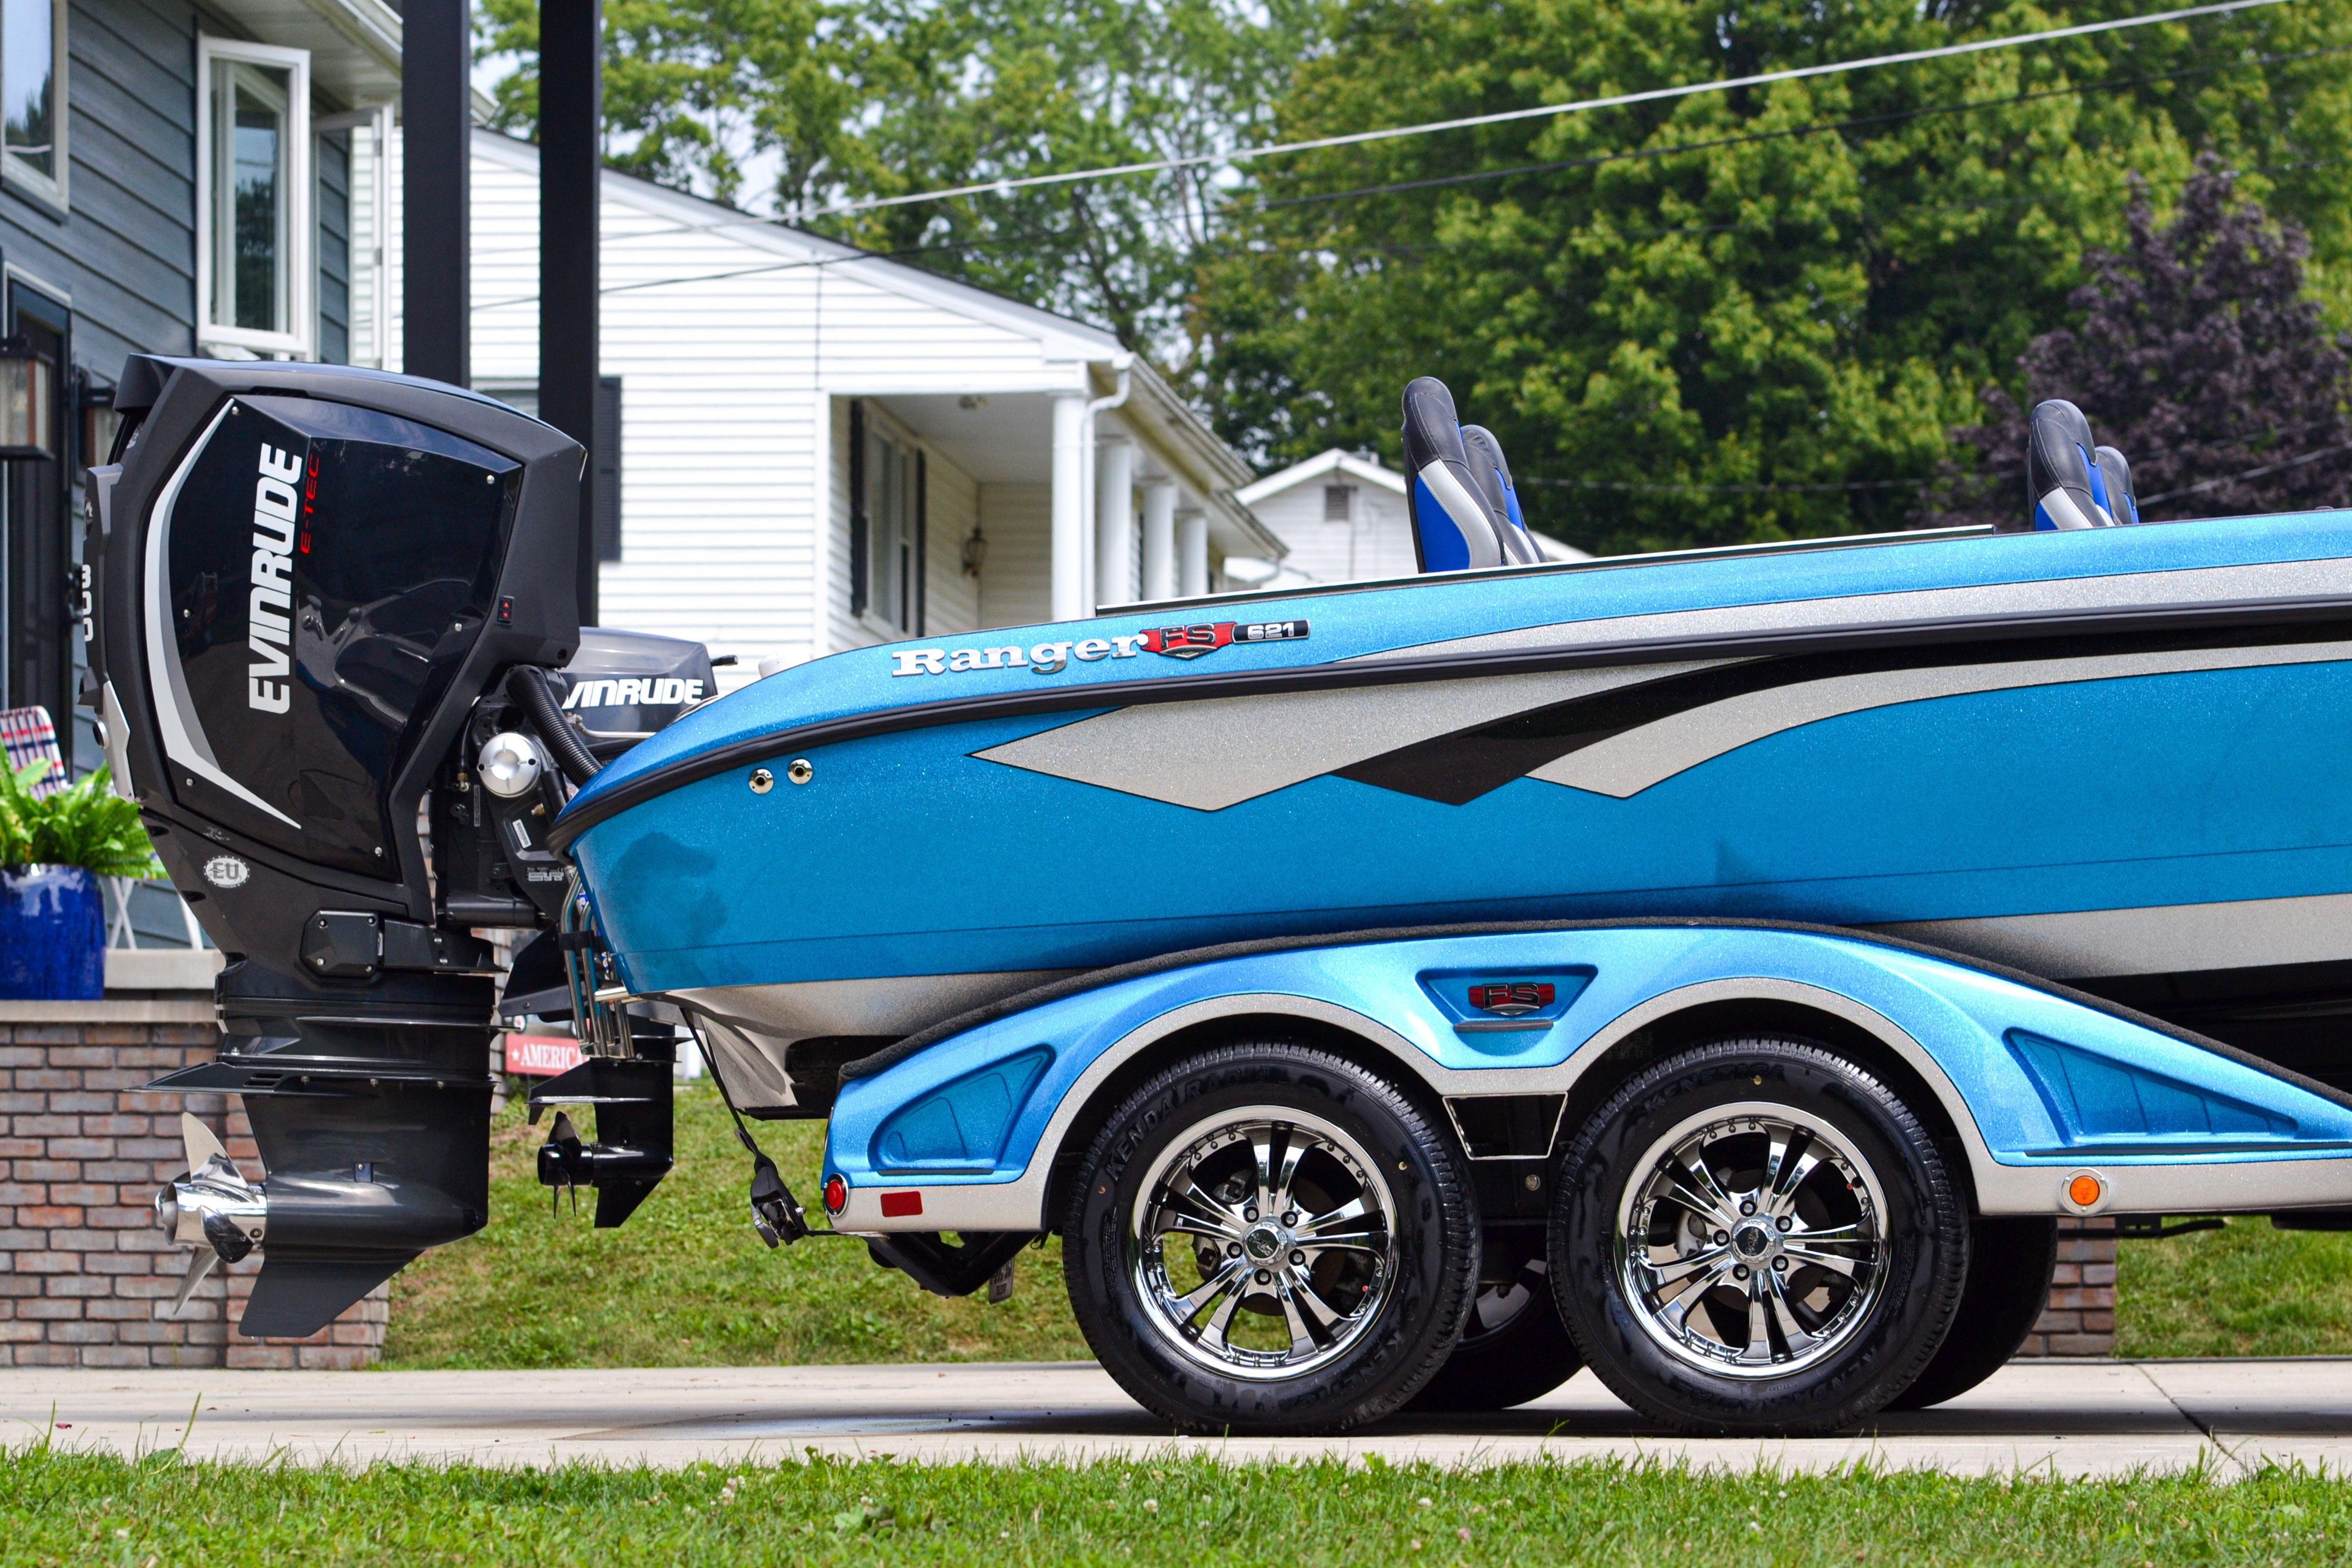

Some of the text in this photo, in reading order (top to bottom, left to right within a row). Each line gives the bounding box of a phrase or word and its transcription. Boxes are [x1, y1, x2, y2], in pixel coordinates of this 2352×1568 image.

[300, 453, 320, 554] E-TEC
[249, 443, 302, 714] EVINRUDE
[892, 622, 1295, 676] Ranger FS 621
[561, 678, 704, 709] VINRUDE
[212, 862, 239, 879] EU
[1483, 983, 1540, 1009] FS
[1105, 1096, 1176, 1181] KENDA
